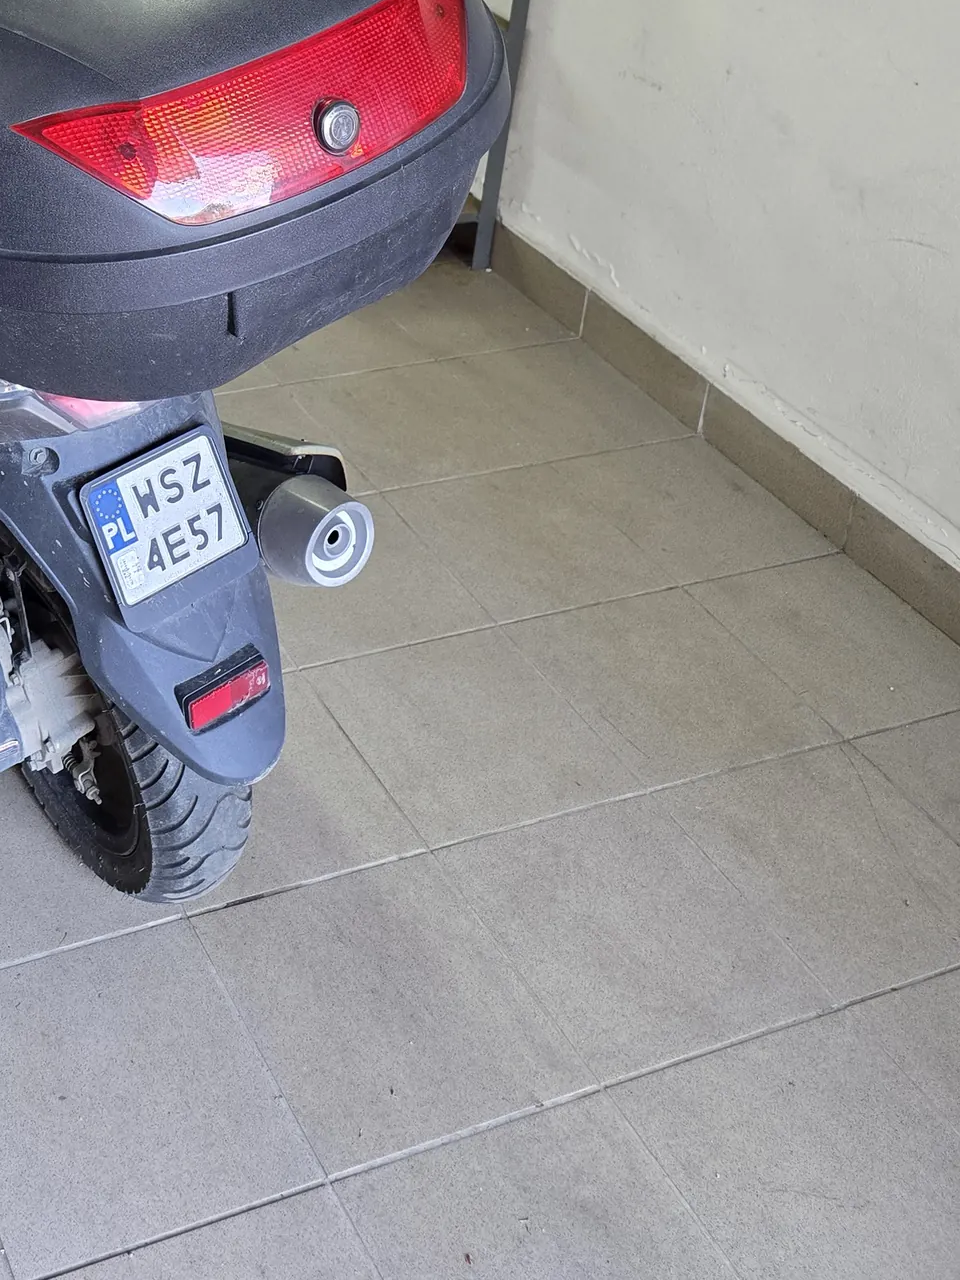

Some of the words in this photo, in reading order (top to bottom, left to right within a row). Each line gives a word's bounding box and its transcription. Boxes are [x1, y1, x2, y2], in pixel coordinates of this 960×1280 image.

[133, 453, 210, 518] WSZ
[102, 517, 135, 550] PL
[147, 503, 223, 572] 4E57
